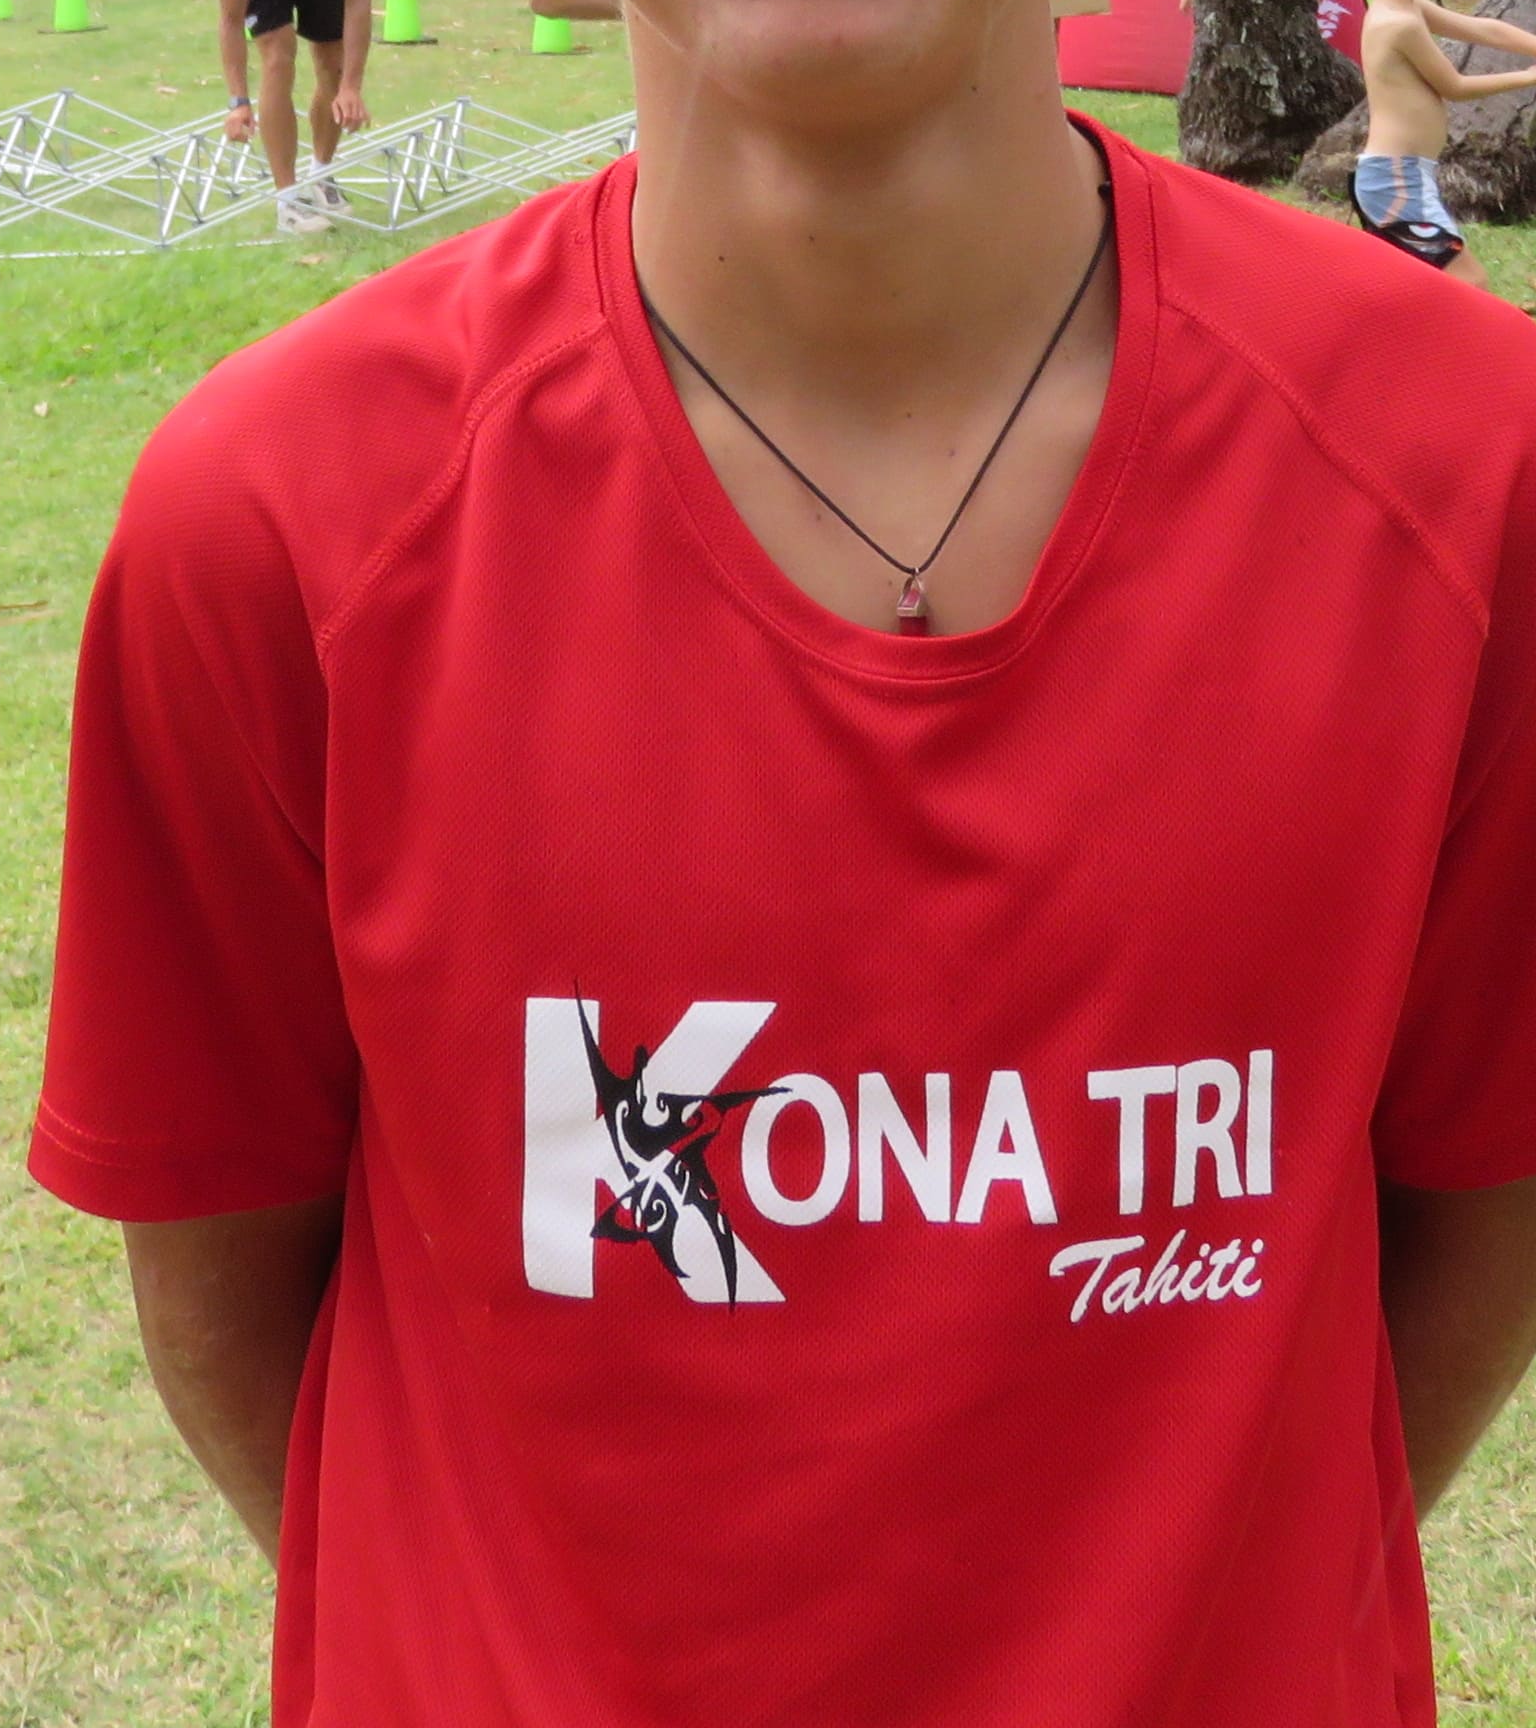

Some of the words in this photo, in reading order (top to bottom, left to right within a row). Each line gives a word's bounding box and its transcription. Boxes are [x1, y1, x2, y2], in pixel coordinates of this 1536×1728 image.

[523, 997, 1058, 1304] KONA
[1088, 1049, 1274, 1215] TRI
[1049, 1229, 1264, 1323] Tahiti
